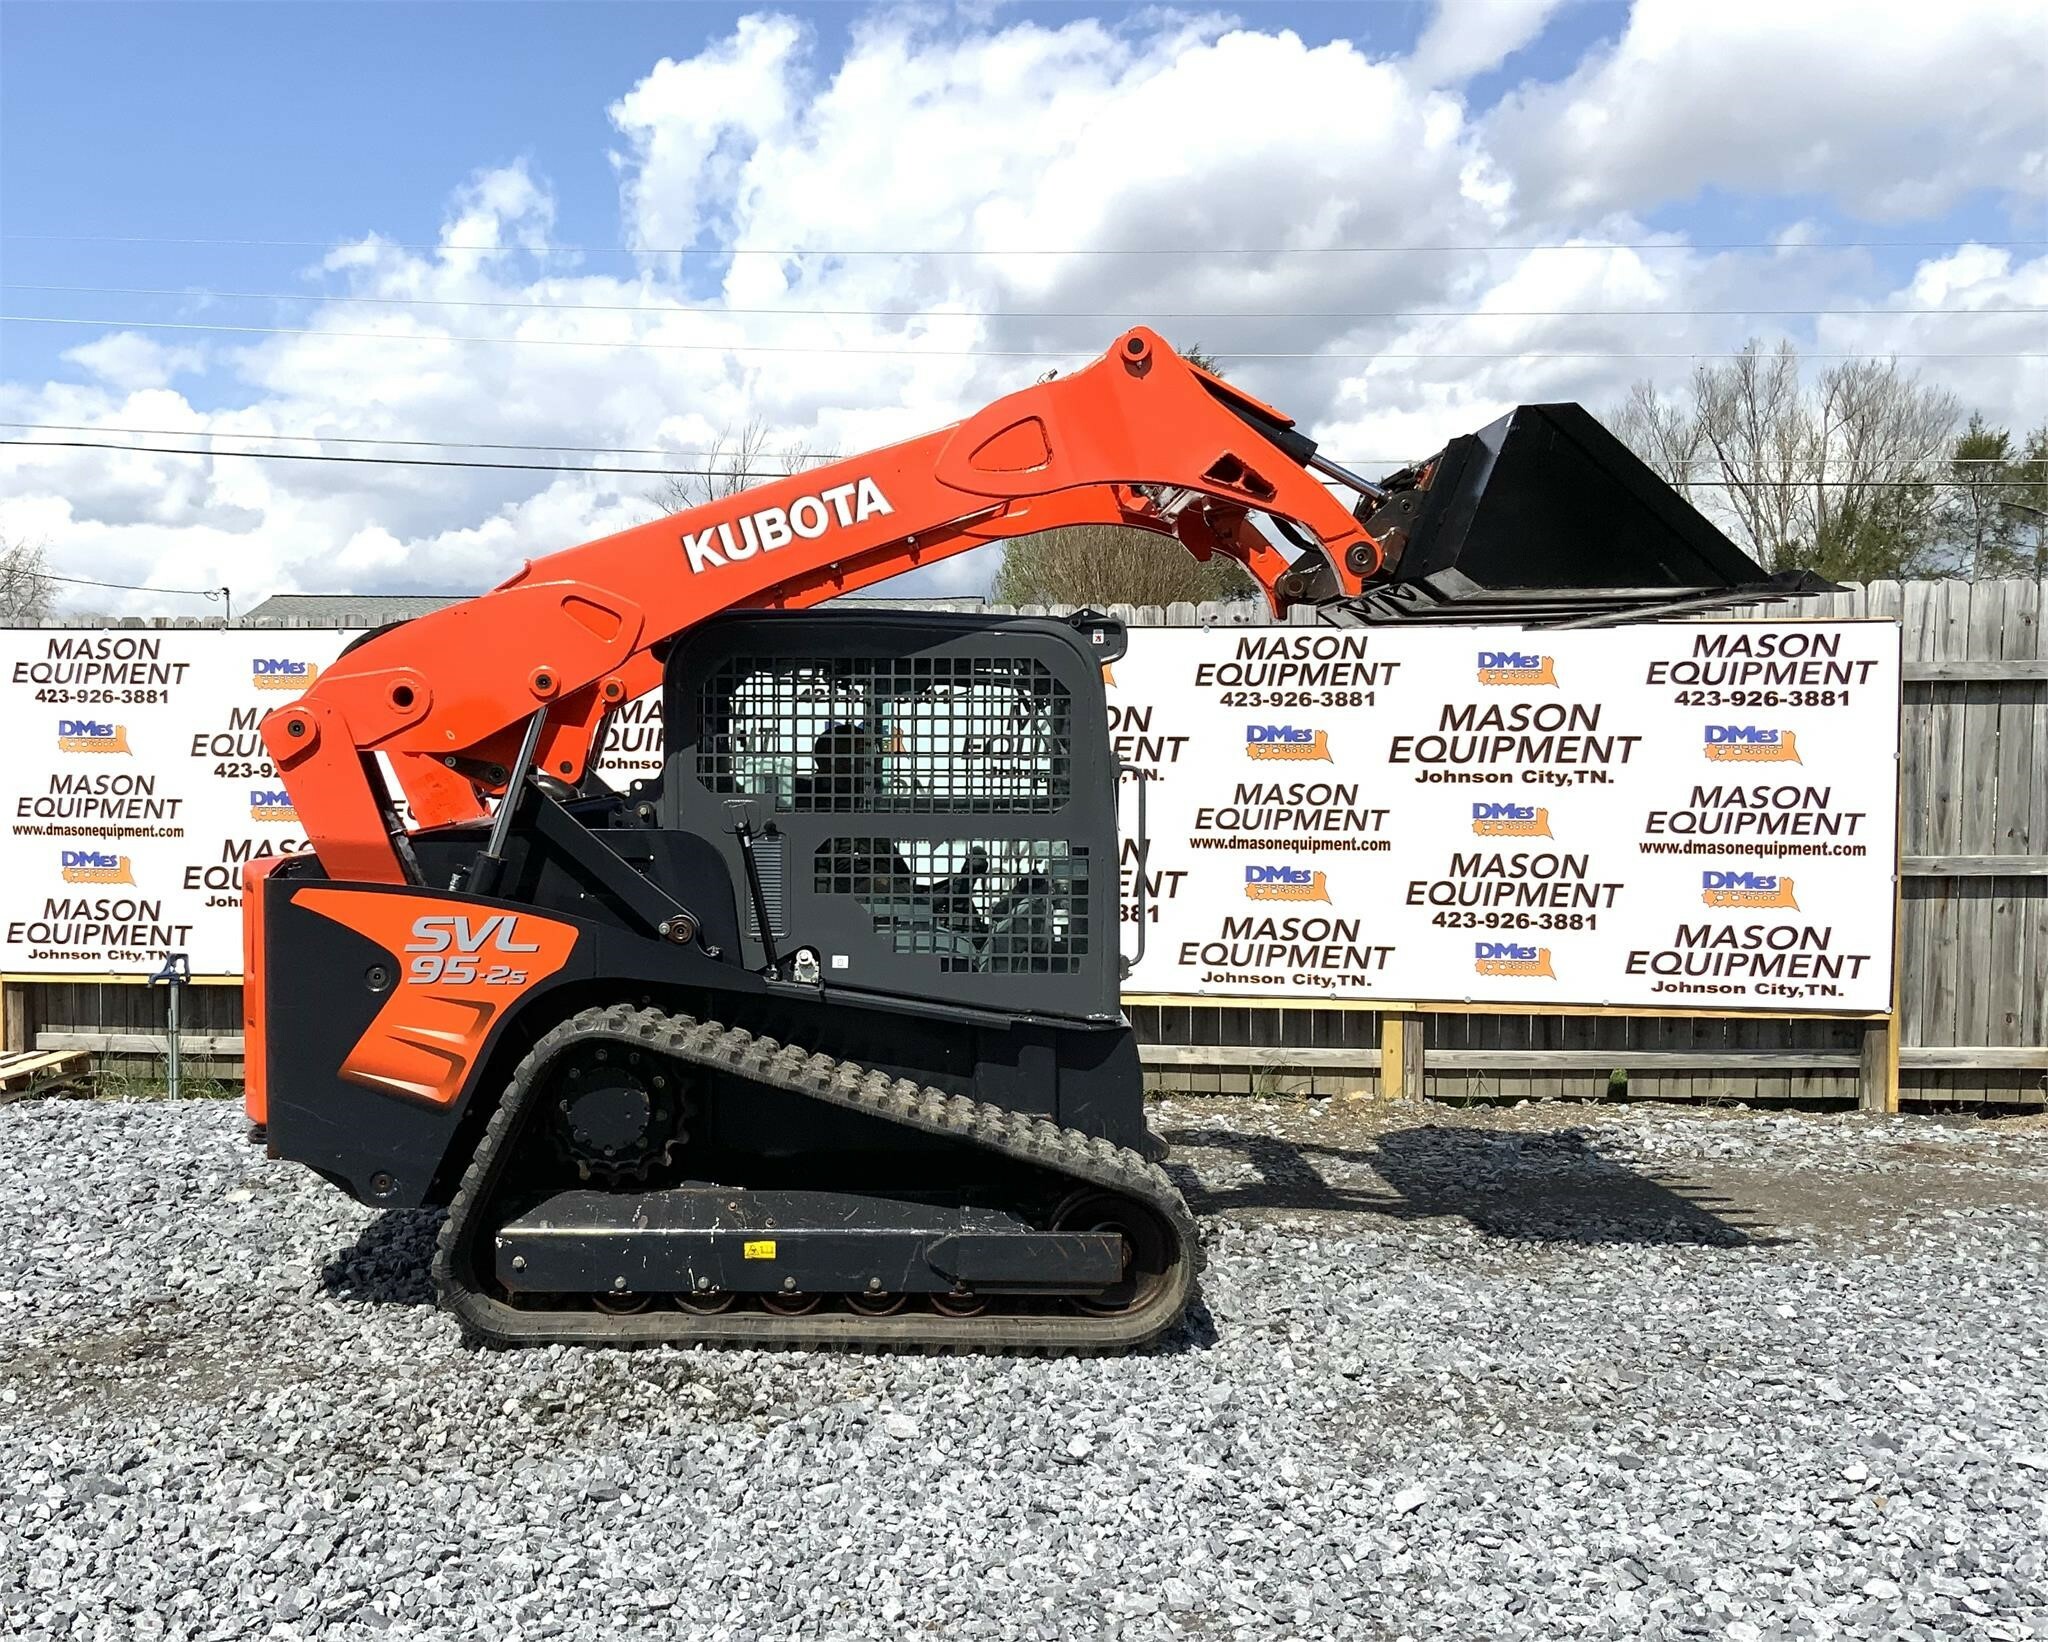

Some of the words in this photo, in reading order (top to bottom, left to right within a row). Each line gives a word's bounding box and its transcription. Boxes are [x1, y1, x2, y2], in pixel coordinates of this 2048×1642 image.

[682, 476, 895, 574] KUBOTA
[47, 637, 161, 660] MASON
[1235, 635, 1369, 661] MASON
[1692, 633, 1841, 659] MASON
[12, 661, 190, 685] EQUIPMENT
[1194, 662, 1401, 687] EQUIPMENT
[1646, 660, 1879, 686] EQUIPMENT
[34, 688, 168, 704] 423-926-3881
[1219, 691, 1375, 707] 423-926-3881
[1674, 690, 1849, 707] 423-926-3881
[1438, 703, 1602, 733] MASON
[1388, 735, 1643, 764] EQUIPMENT
[599, 757, 664, 770] Johnso
[49, 774, 155, 796] MASON
[1414, 769, 1513, 784] Johnson
[1233, 783, 1359, 806] MASON
[1689, 785, 1831, 810] MASON
[16, 797, 183, 820] EQUIPMENT
[1194, 808, 1391, 832] EQUIPMENT
[12, 822, 184, 840] www.dmasonequipment.com
[1645, 810, 1867, 836] EQUIPMENT
[222, 838, 312, 864] MAS
[1189, 836, 1391, 854] www.dmasonequipment.com
[1639, 839, 1867, 859] www.dmasonequipment.com
[1449, 852, 1590, 880] MASON
[1405, 880, 1625, 909] EQUIPMENT
[43, 898, 161, 922] MASON
[1431, 911, 1597, 931] 423-926-3881
[6, 922, 194, 947] EQUIPMENT
[404, 916, 540, 952] SVL
[1221, 916, 1361, 943] MASON
[1674, 924, 1832, 951] MASON
[28, 948, 102, 960] Johnson
[107, 949, 171, 963] City,TN
[1178, 942, 1396, 970] EQUIPMENT
[1625, 950, 1871, 980] EQUIPMENT
[1200, 971, 1285, 985] Johnson
[1650, 980, 1746, 995] Johnson
